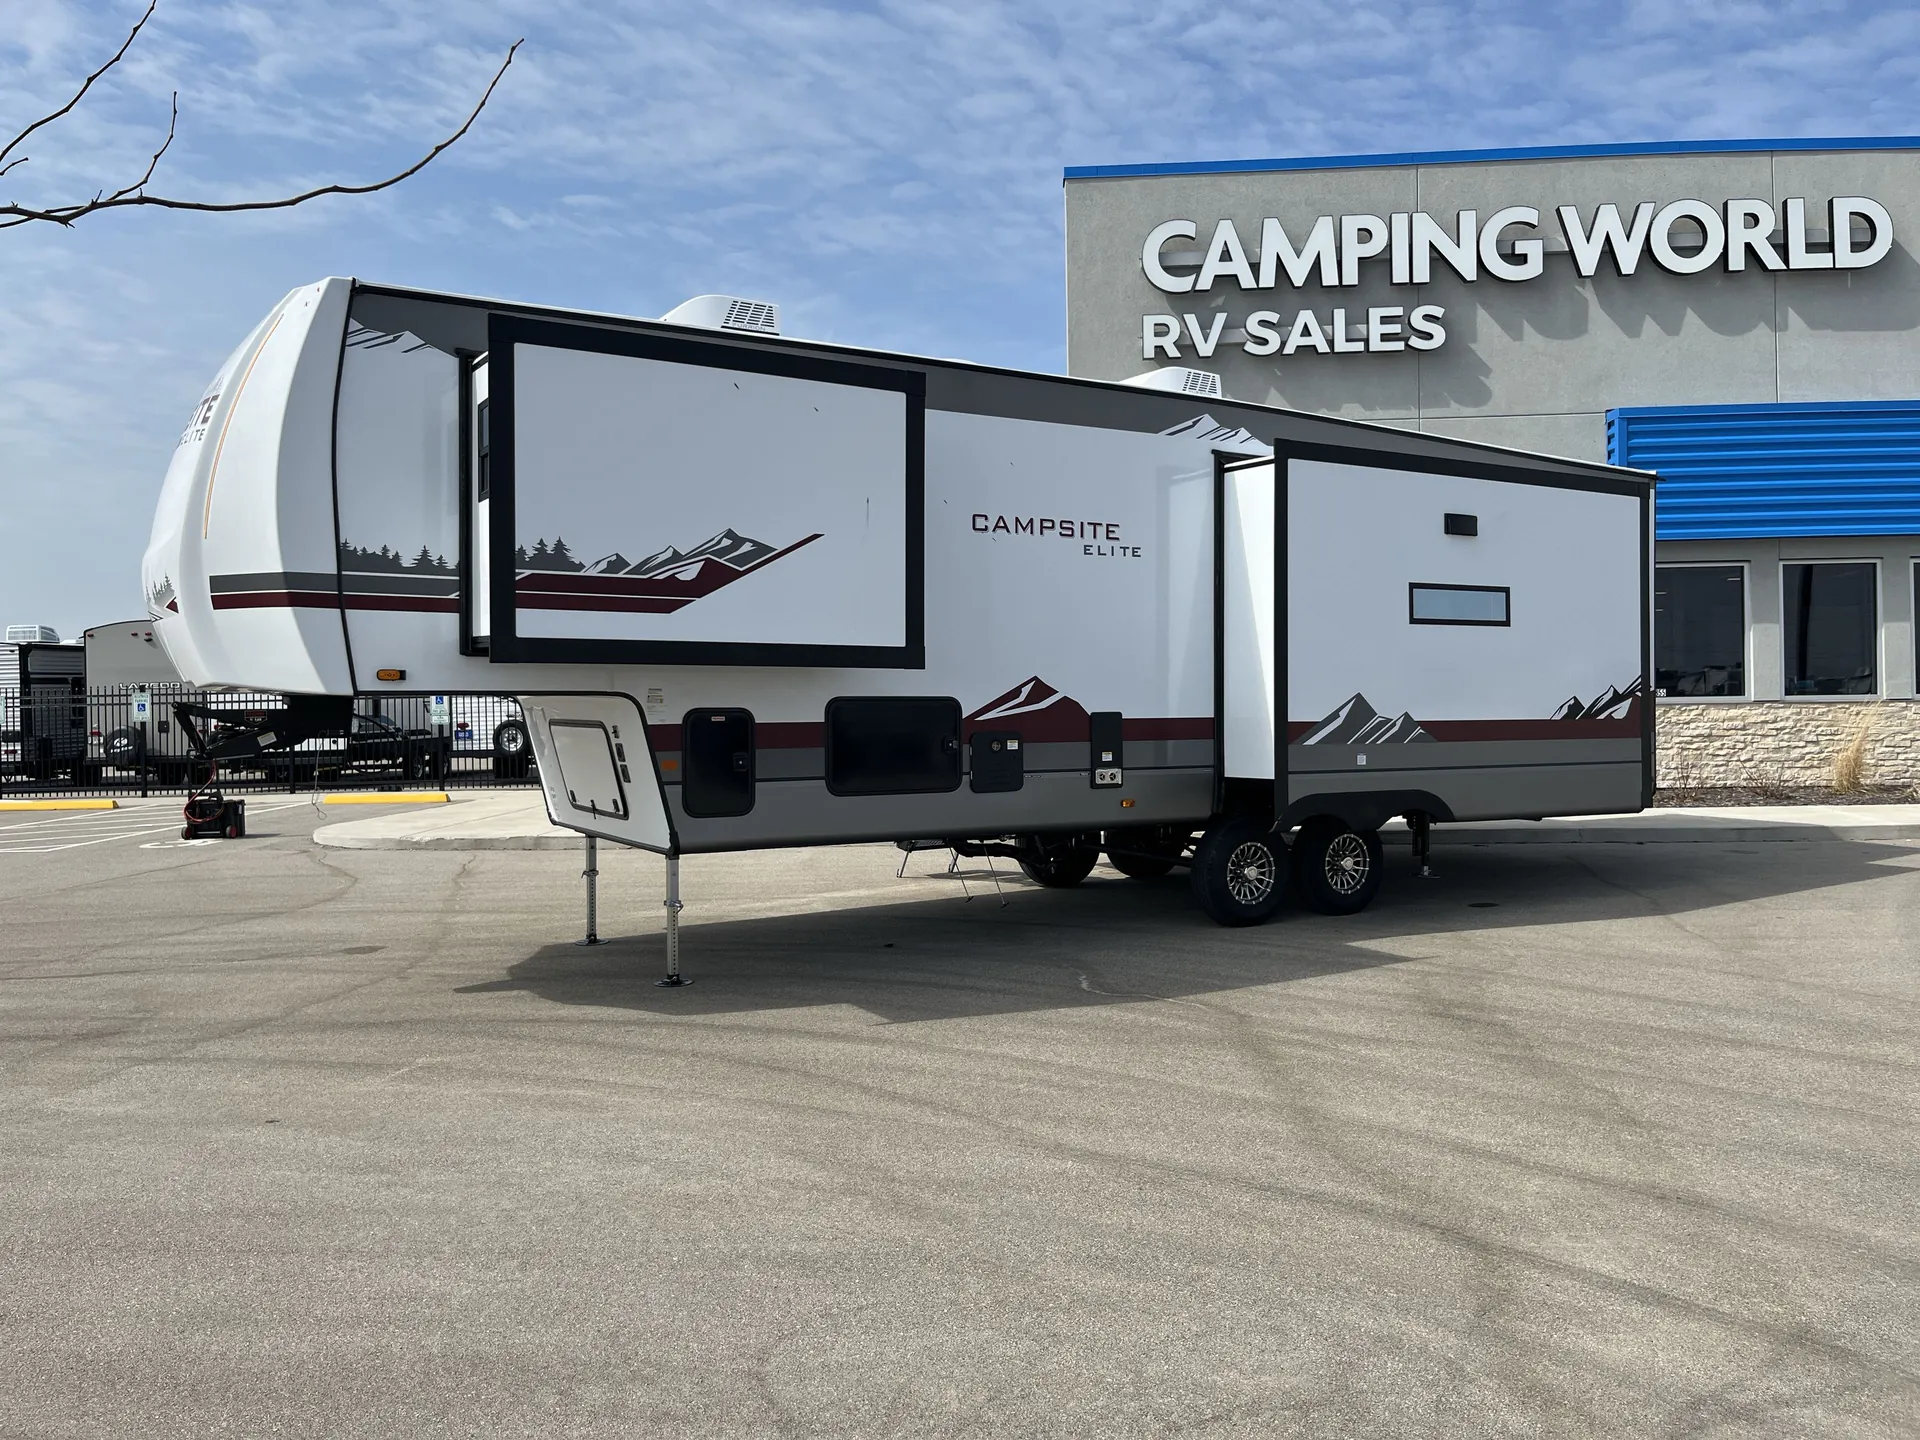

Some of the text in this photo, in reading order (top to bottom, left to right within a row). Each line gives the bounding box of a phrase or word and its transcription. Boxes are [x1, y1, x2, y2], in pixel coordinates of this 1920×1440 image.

[1142, 197, 1895, 294] CAMPING WORLD
[1142, 304, 1448, 360] RV SALES
[972, 514, 1120, 541] CAMPSITE
[1083, 545, 1142, 557] ELITE
